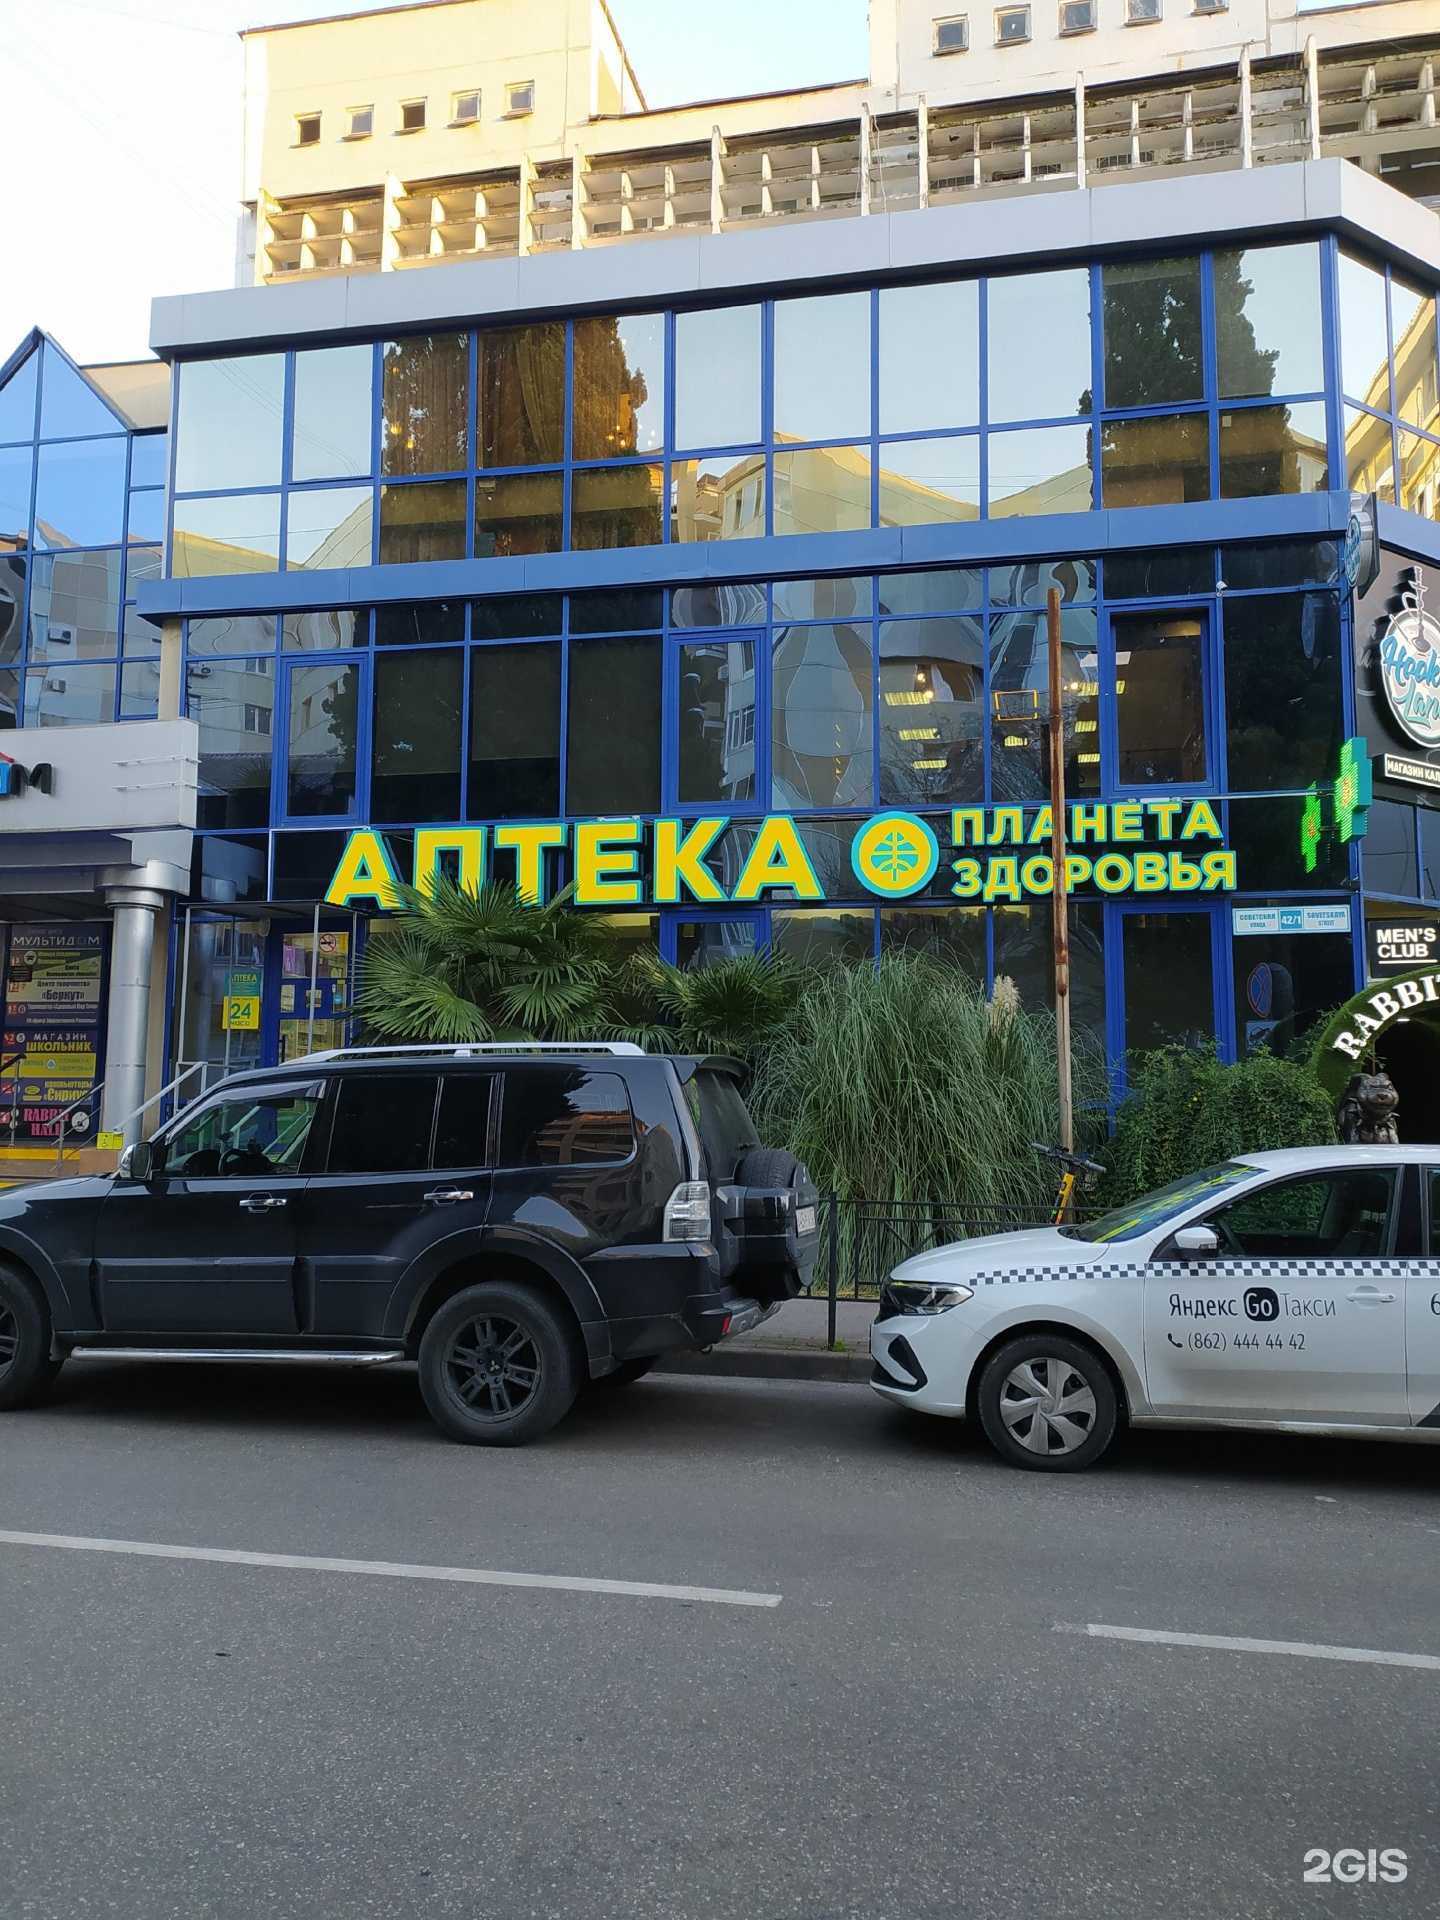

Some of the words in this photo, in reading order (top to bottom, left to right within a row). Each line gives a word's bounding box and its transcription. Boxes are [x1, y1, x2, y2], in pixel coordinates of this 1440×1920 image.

[1387, 760, 1425, 779] МАГАЗИН
[951, 800, 1225, 847] ПЛАНЕТА
[324, 815, 826, 910] АПТЕКА
[951, 850, 1238, 902] ЗДОРОВЬЯ
[1281, 915, 1302, 925] 42/1
[1376, 927, 1437, 944] MEN'S
[1377, 943, 1430, 959] CLUB
[230, 1003, 252, 1019] 24
[33, 1033, 87, 1041] МАГАЗИН
[26, 1041, 92, 1052] ШКОЛЬНИК
[1169, 1293, 1238, 1319] Яндекс
[1246, 1292, 1274, 1318] Go
[1281, 1293, 1336, 1317] Такси
[1187, 1332, 1227, 1351] (862)
[1233, 1333, 1259, 1349] 444
[1265, 1333, 1283, 1349] 44
[1289, 1333, 1306, 1350] 42
